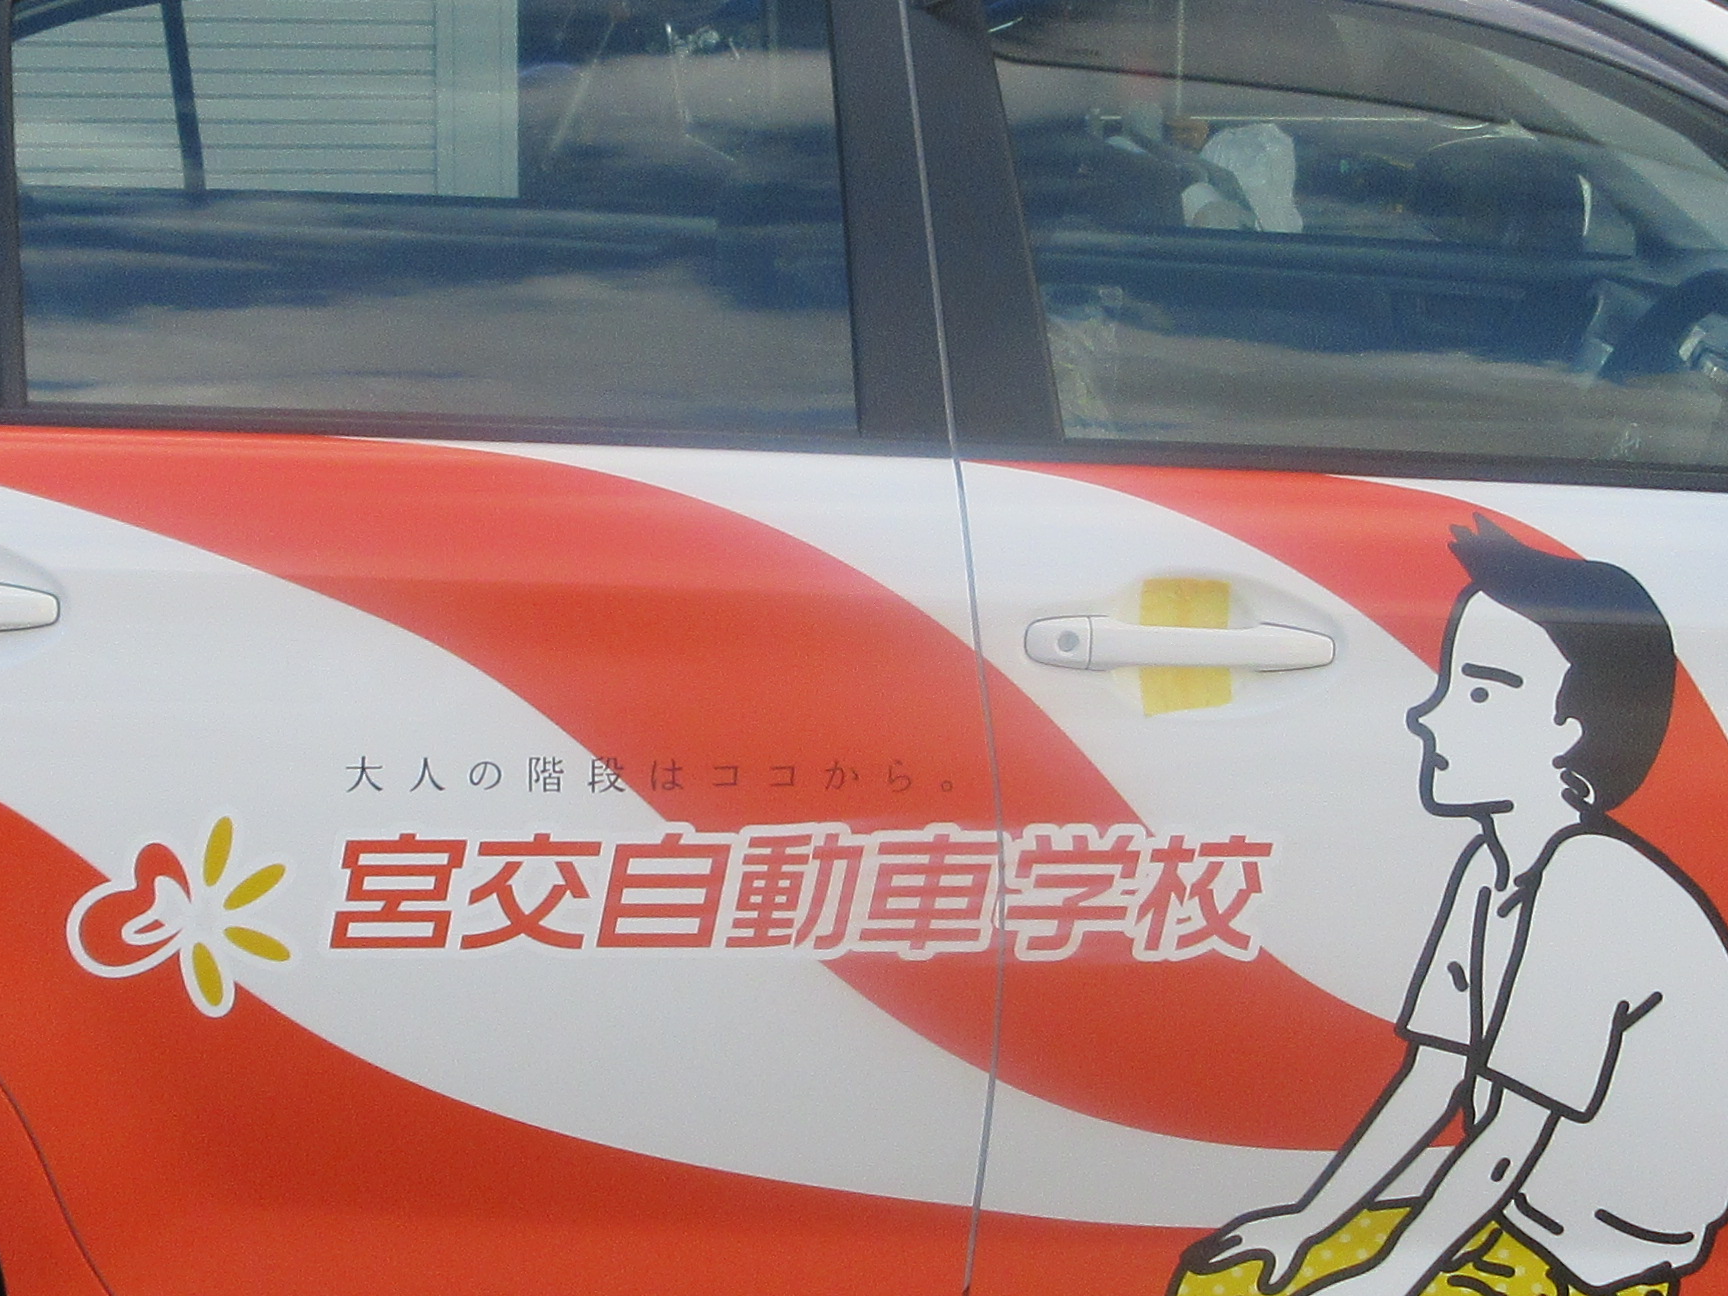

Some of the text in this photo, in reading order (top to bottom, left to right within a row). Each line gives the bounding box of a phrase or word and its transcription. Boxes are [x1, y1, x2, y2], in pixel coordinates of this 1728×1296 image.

[344, 754, 955, 794] 大人の階段はココから。
[329, 832, 1274, 953] 宮交自動車学校
